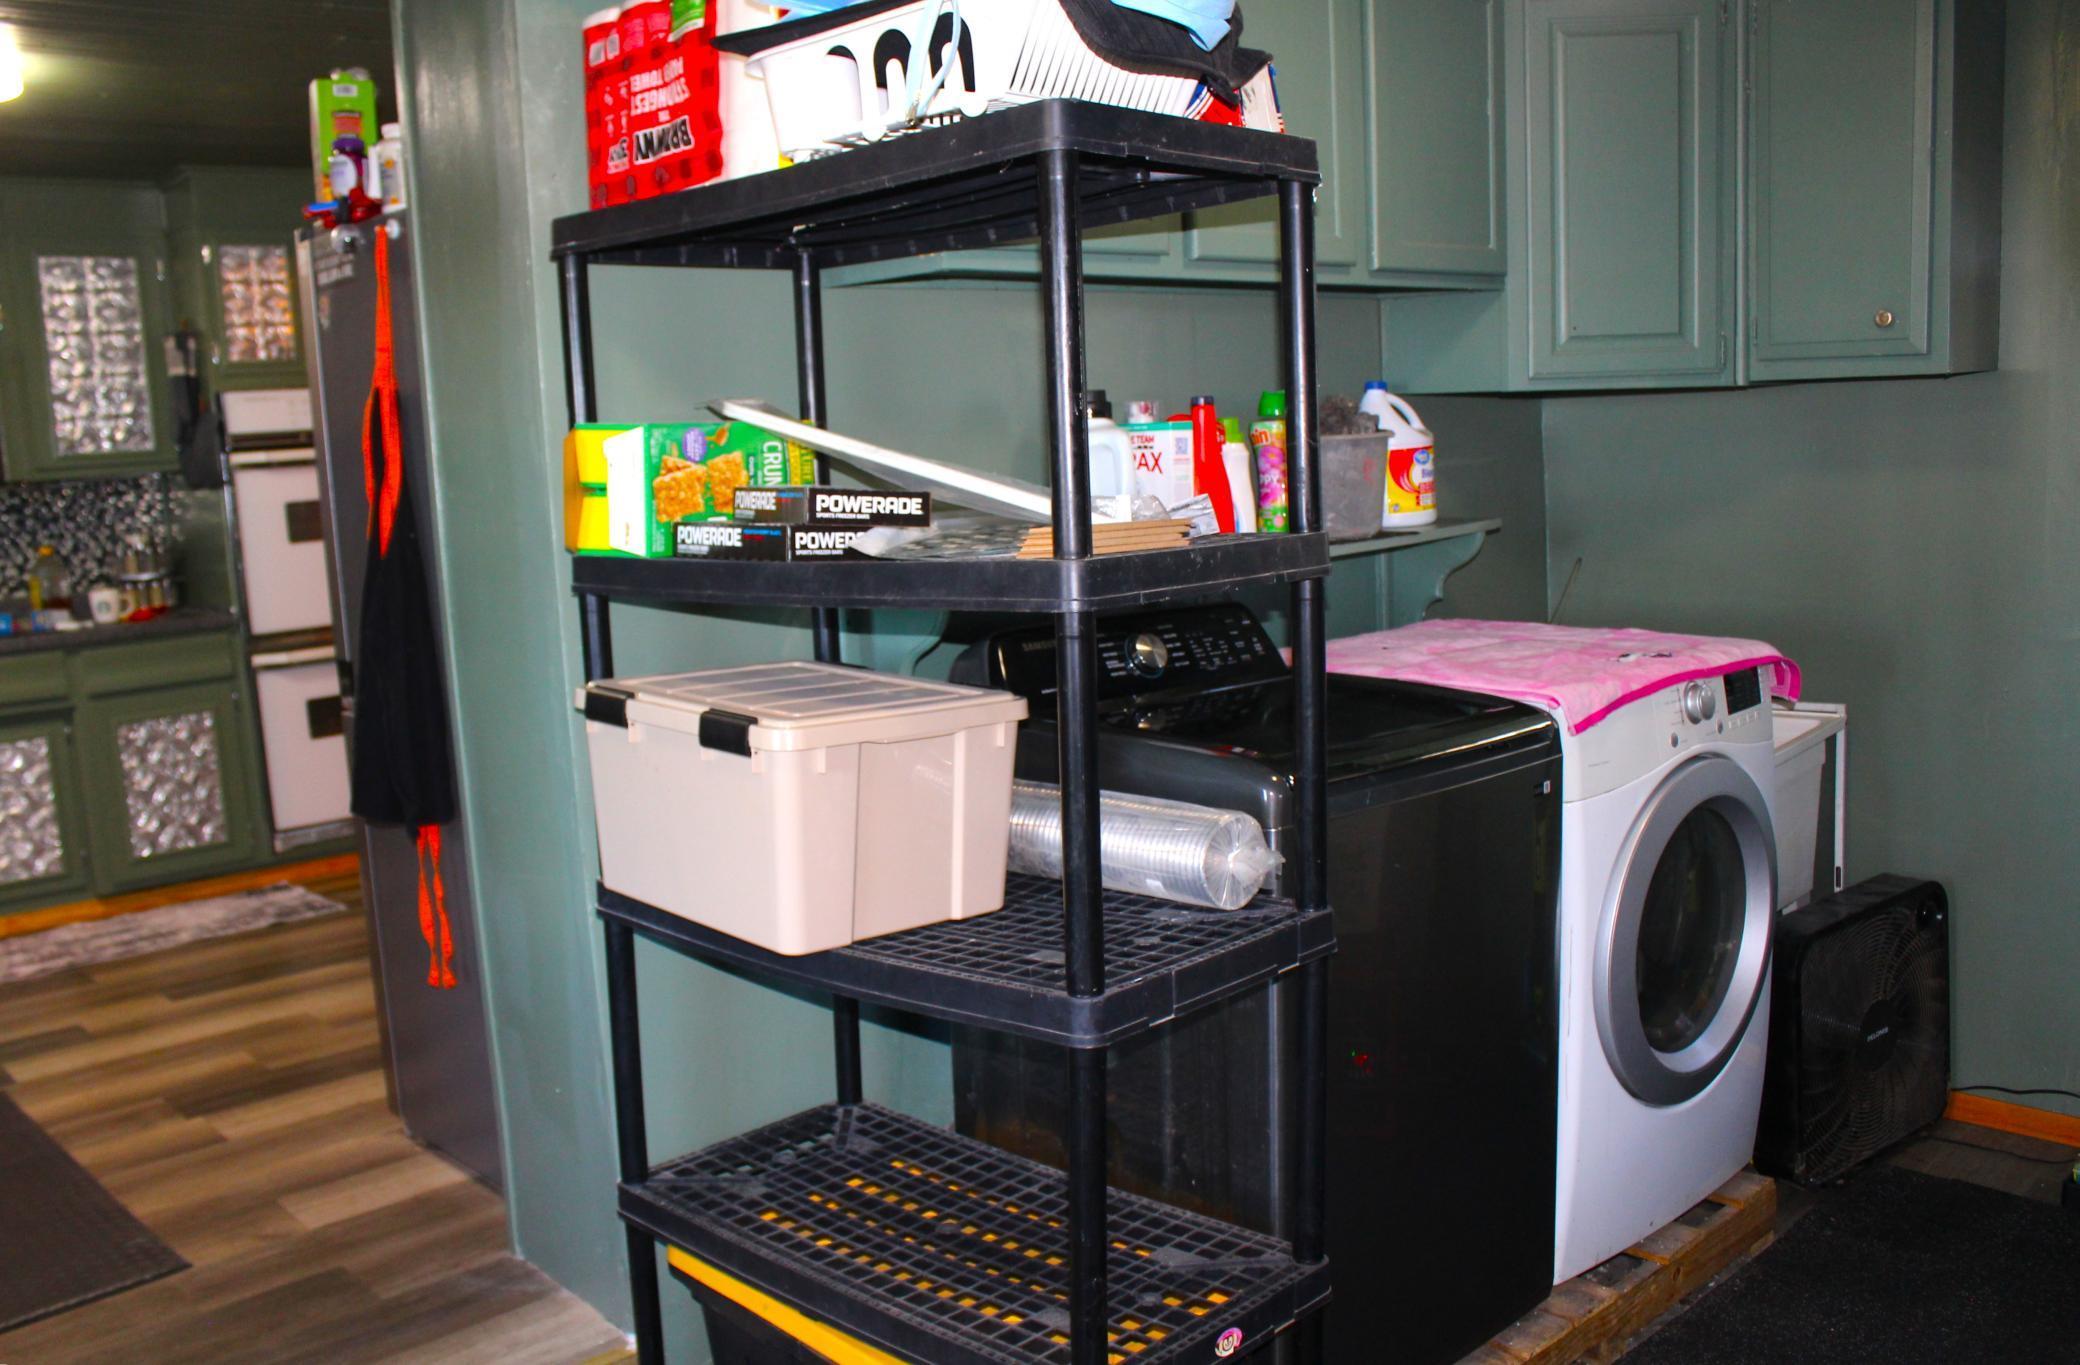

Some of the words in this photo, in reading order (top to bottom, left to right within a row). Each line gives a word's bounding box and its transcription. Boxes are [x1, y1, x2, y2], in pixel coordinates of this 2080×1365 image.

[634, 117, 693, 162] BRAWNY
[735, 490, 777, 511] POWERADE
[816, 494, 924, 515] POWERADE
[677, 525, 743, 547] POWERADE
